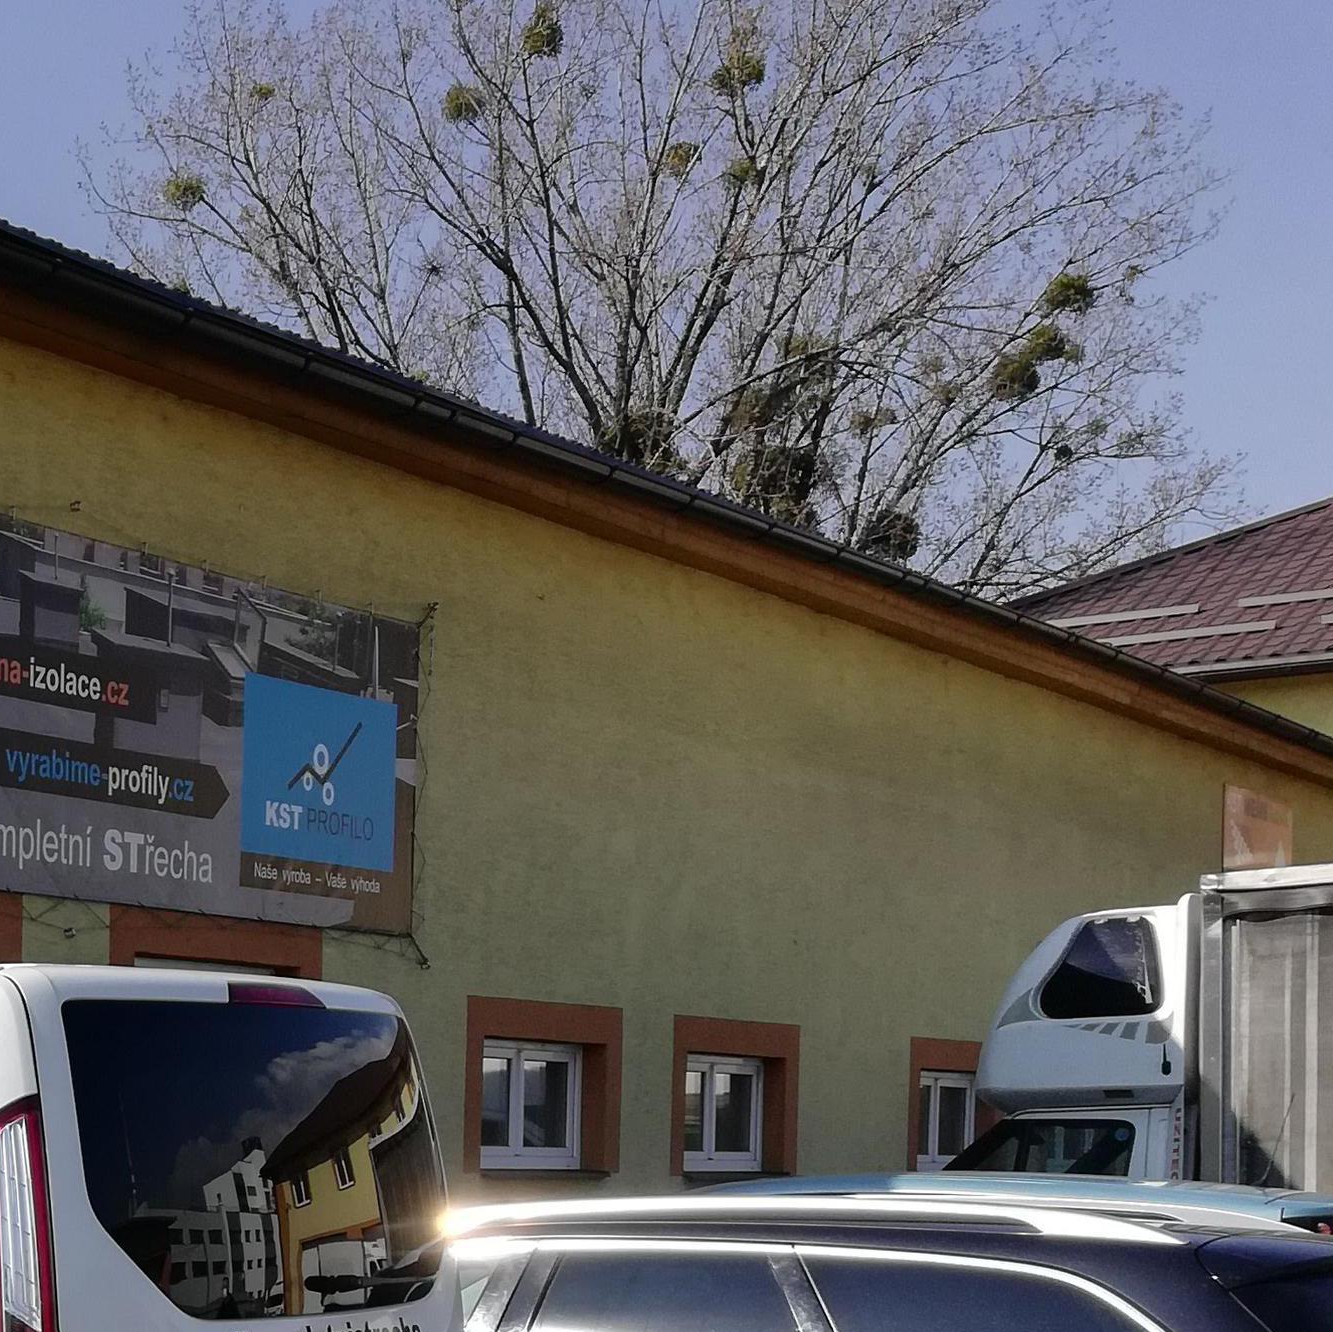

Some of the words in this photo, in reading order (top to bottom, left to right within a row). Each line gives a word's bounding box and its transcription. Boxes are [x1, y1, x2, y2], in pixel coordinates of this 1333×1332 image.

[5, 749, 195, 804] vyrabime-profily.cz
[265, 800, 304, 831] KST
[307, 808, 375, 841] PROFILO
[103, 828, 214, 884] STřecha
[254, 861, 278, 880] Naše
[282, 867, 311, 886] výroba
[325, 871, 347, 889] Vaše
[351, 875, 381, 895] výhoda
